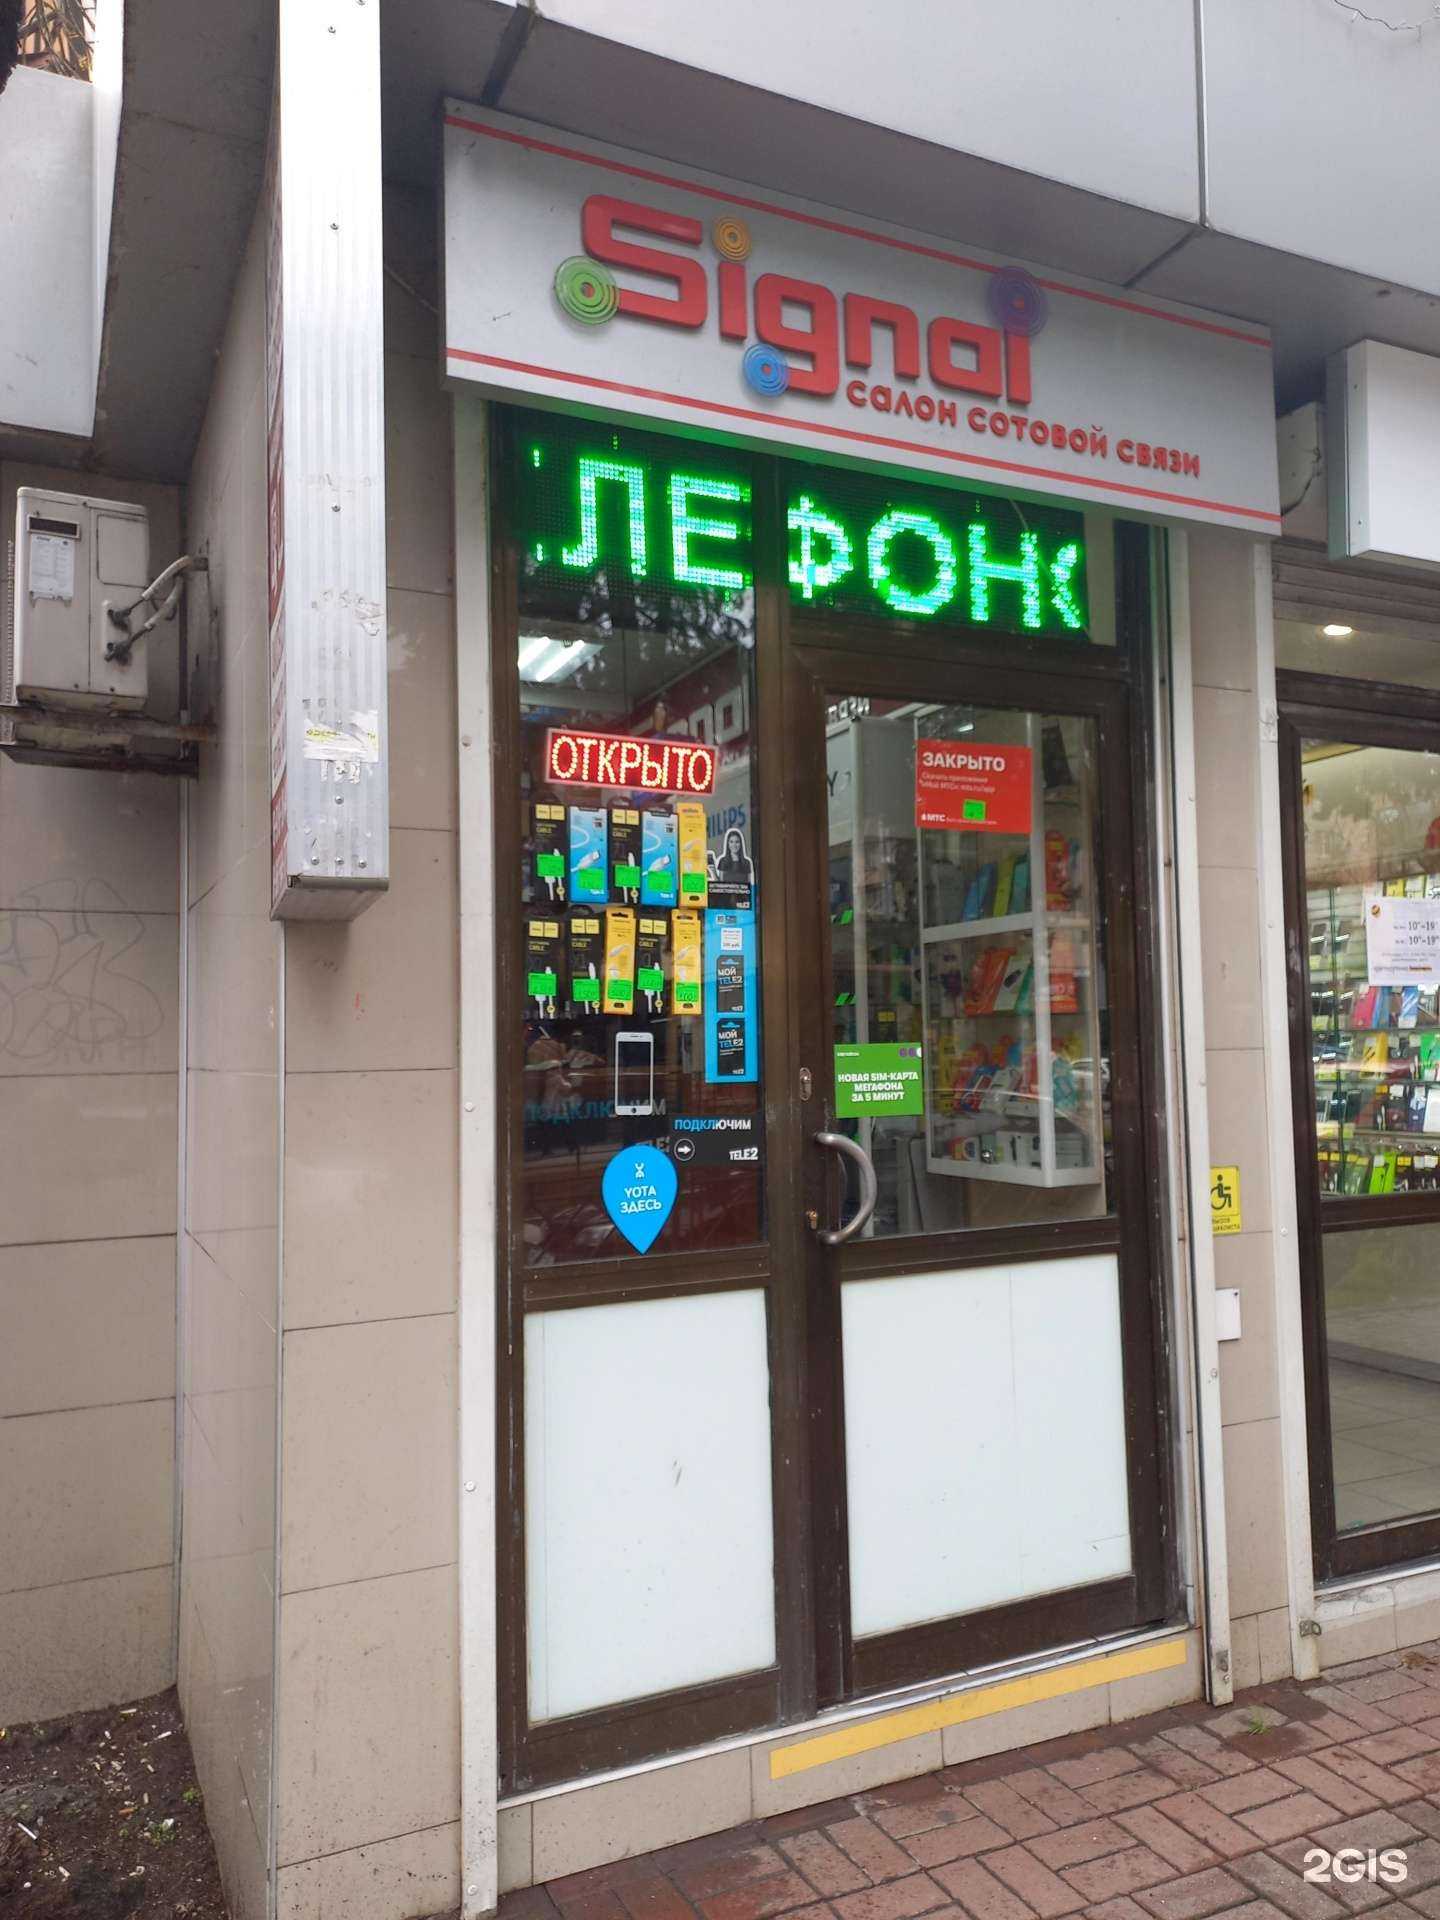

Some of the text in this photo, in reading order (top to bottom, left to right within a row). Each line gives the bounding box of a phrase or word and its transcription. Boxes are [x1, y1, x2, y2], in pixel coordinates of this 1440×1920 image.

[581, 194, 1031, 405] Signal
[551, 735, 713, 791] ОТКРЫТО
[922, 751, 1006, 772] ЗАКРЫТО
[837, 1071, 919, 1082] НОВАЯ SIM-КАРТА
[854, 1082, 904, 1092] МЕГАФОНА
[851, 1092, 905, 1102] ЗА 5 МИНУТ
[674, 1118, 751, 1132] ПОДКЛЮЧИМ
[729, 1147, 759, 1161] TELE2
[624, 1184, 657, 1198] YOTA
[620, 1199, 662, 1214] ЗДЕСЬ
